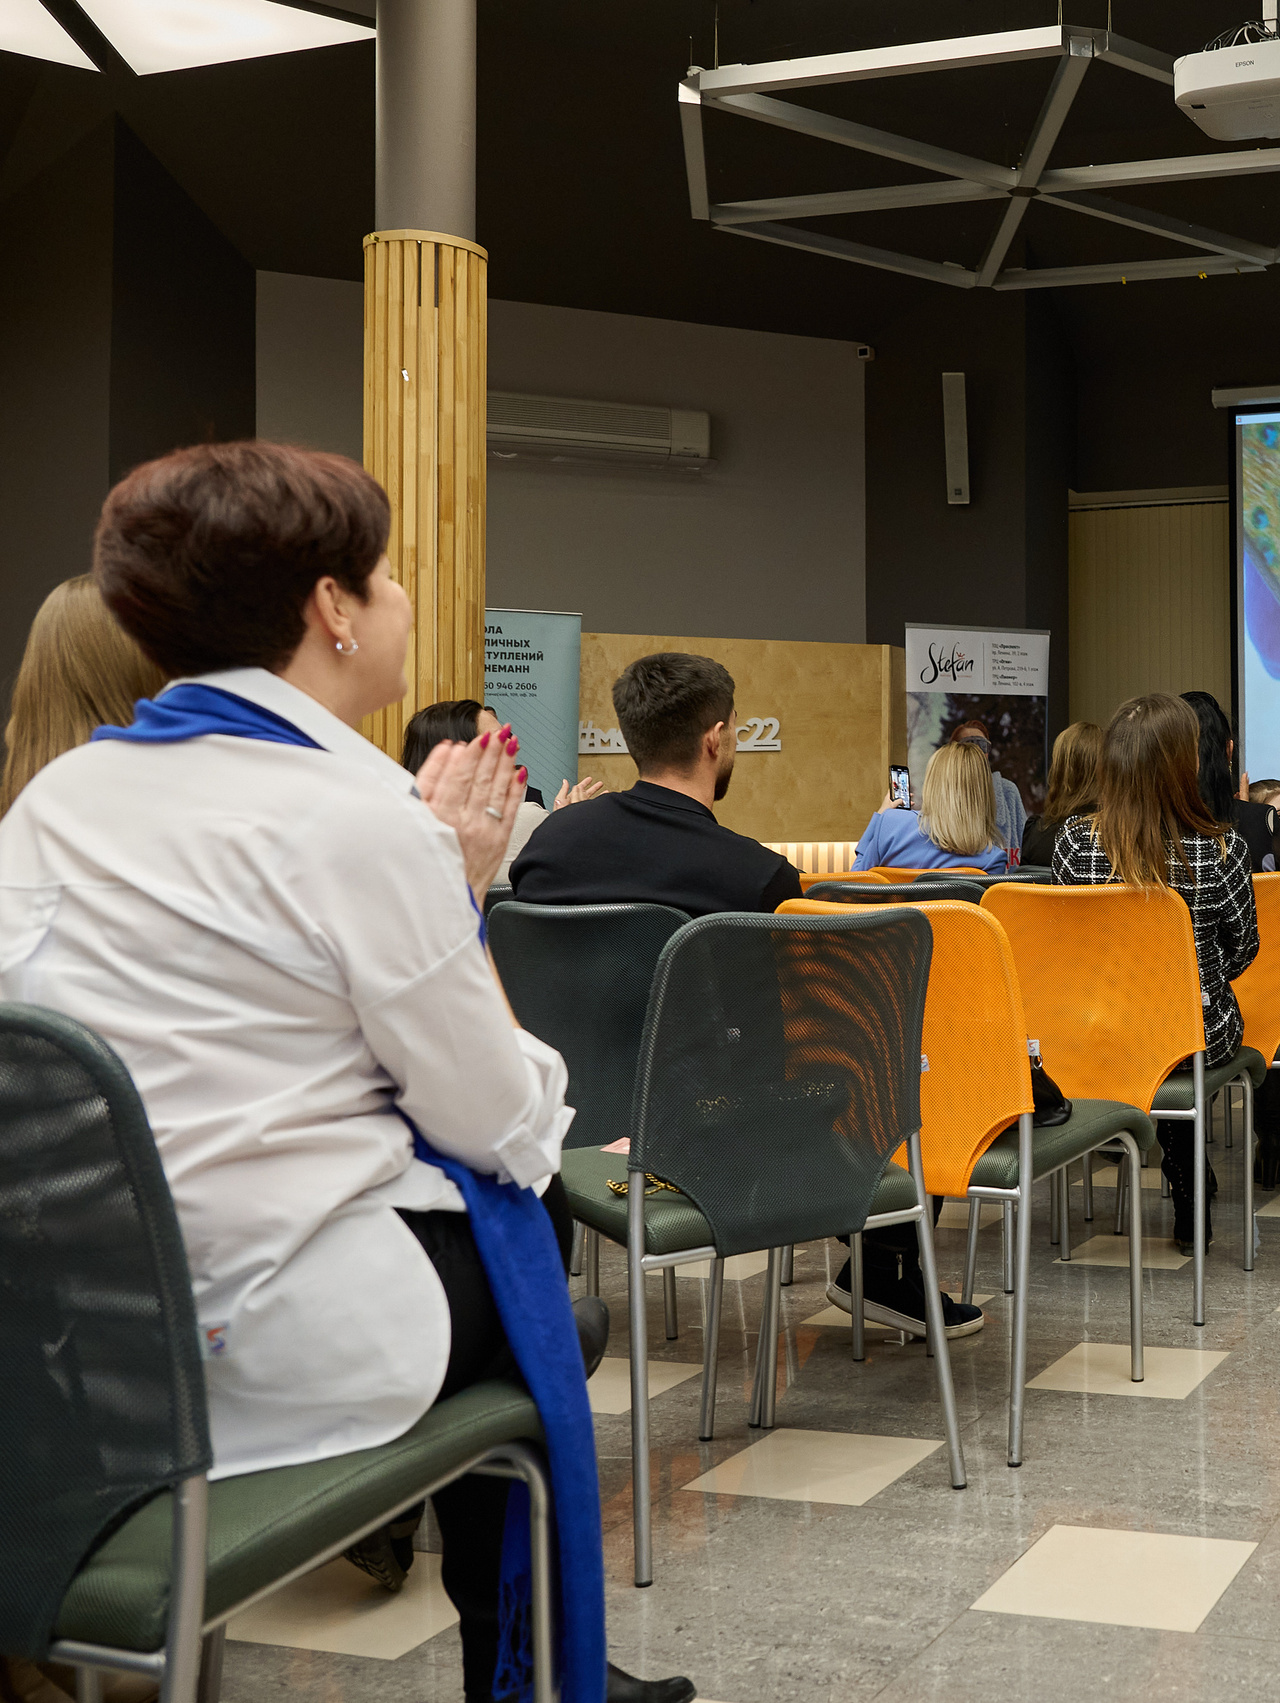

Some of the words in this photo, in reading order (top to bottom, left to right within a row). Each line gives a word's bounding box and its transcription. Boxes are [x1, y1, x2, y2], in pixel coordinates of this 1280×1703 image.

[484, 651, 544, 661] ТУПЛЕНИЙ
[920, 642, 974, 684] Stefan
[485, 664, 530, 673] НЕМАНН
[496, 682, 513, 690] 946
